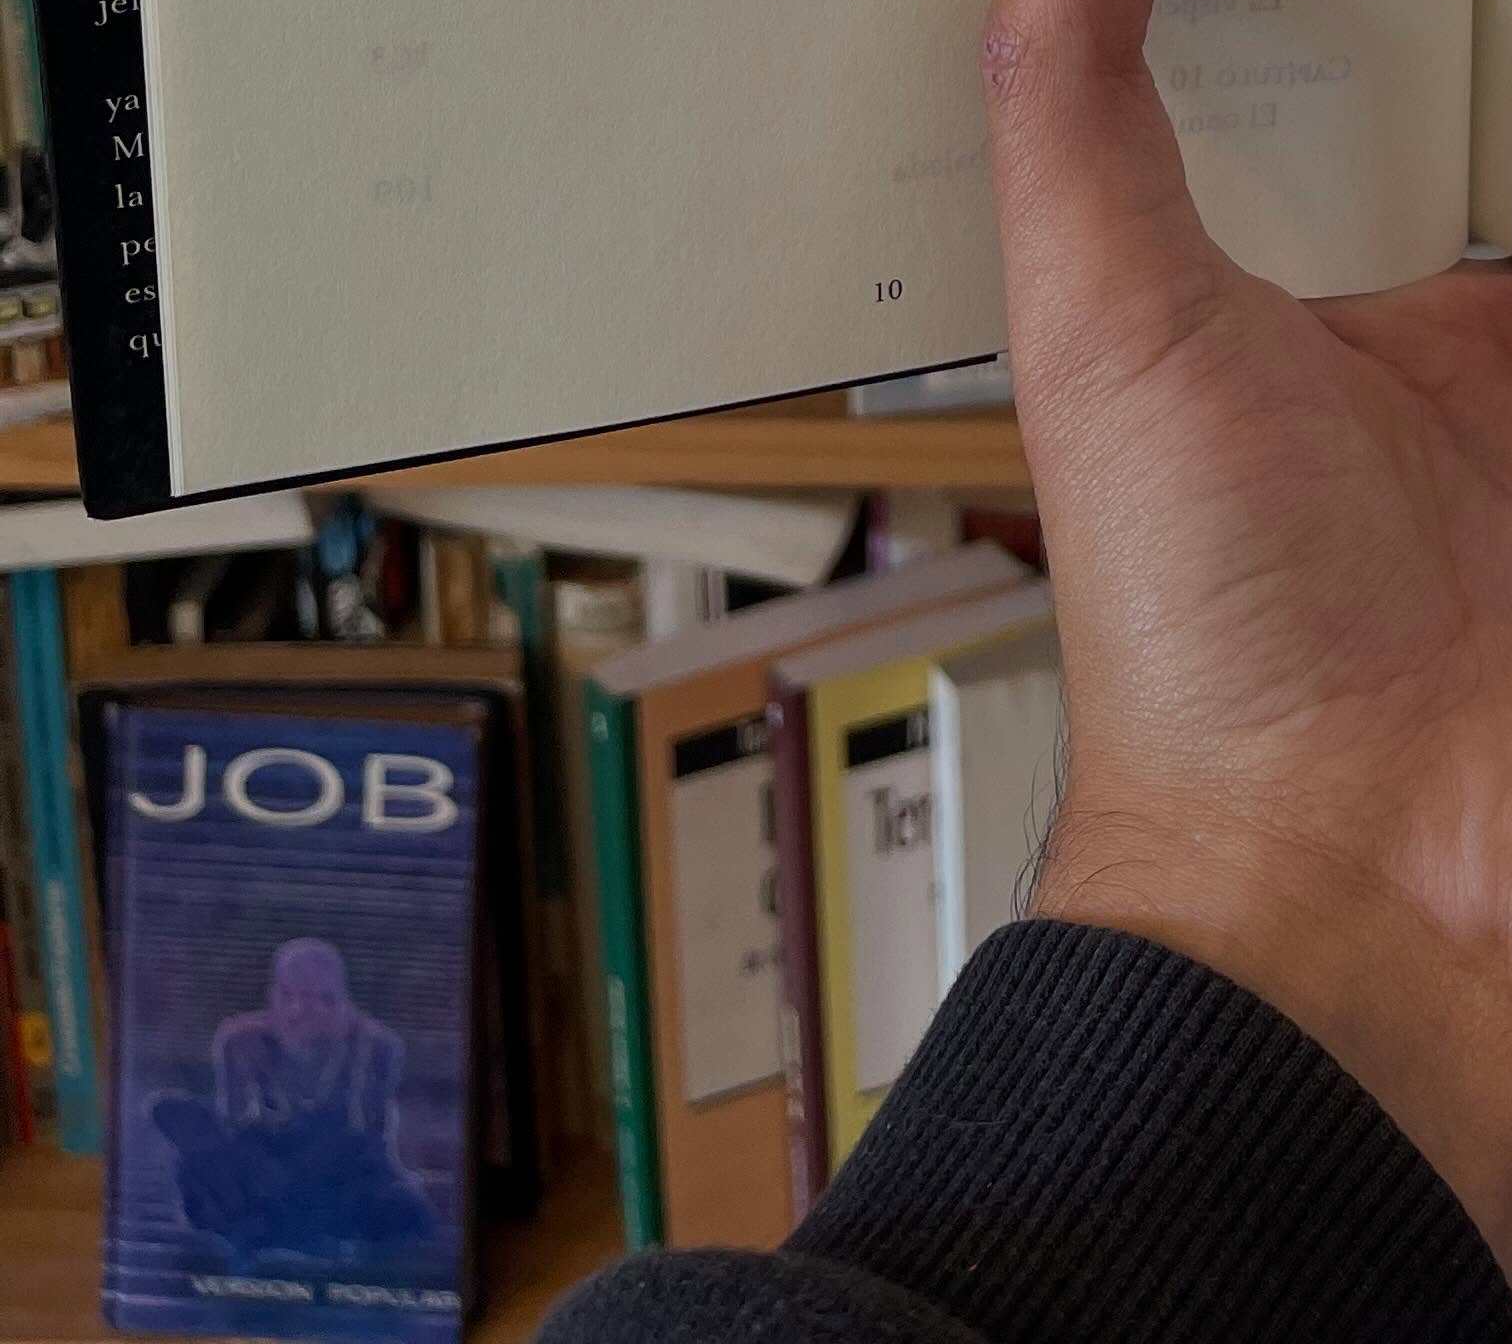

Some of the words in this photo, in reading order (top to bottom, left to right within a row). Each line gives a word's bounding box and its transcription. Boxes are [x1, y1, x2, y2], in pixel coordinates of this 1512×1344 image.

[115, 183, 143, 209] la
[876, 280, 902, 302] 10
[128, 744, 459, 833] JOB
